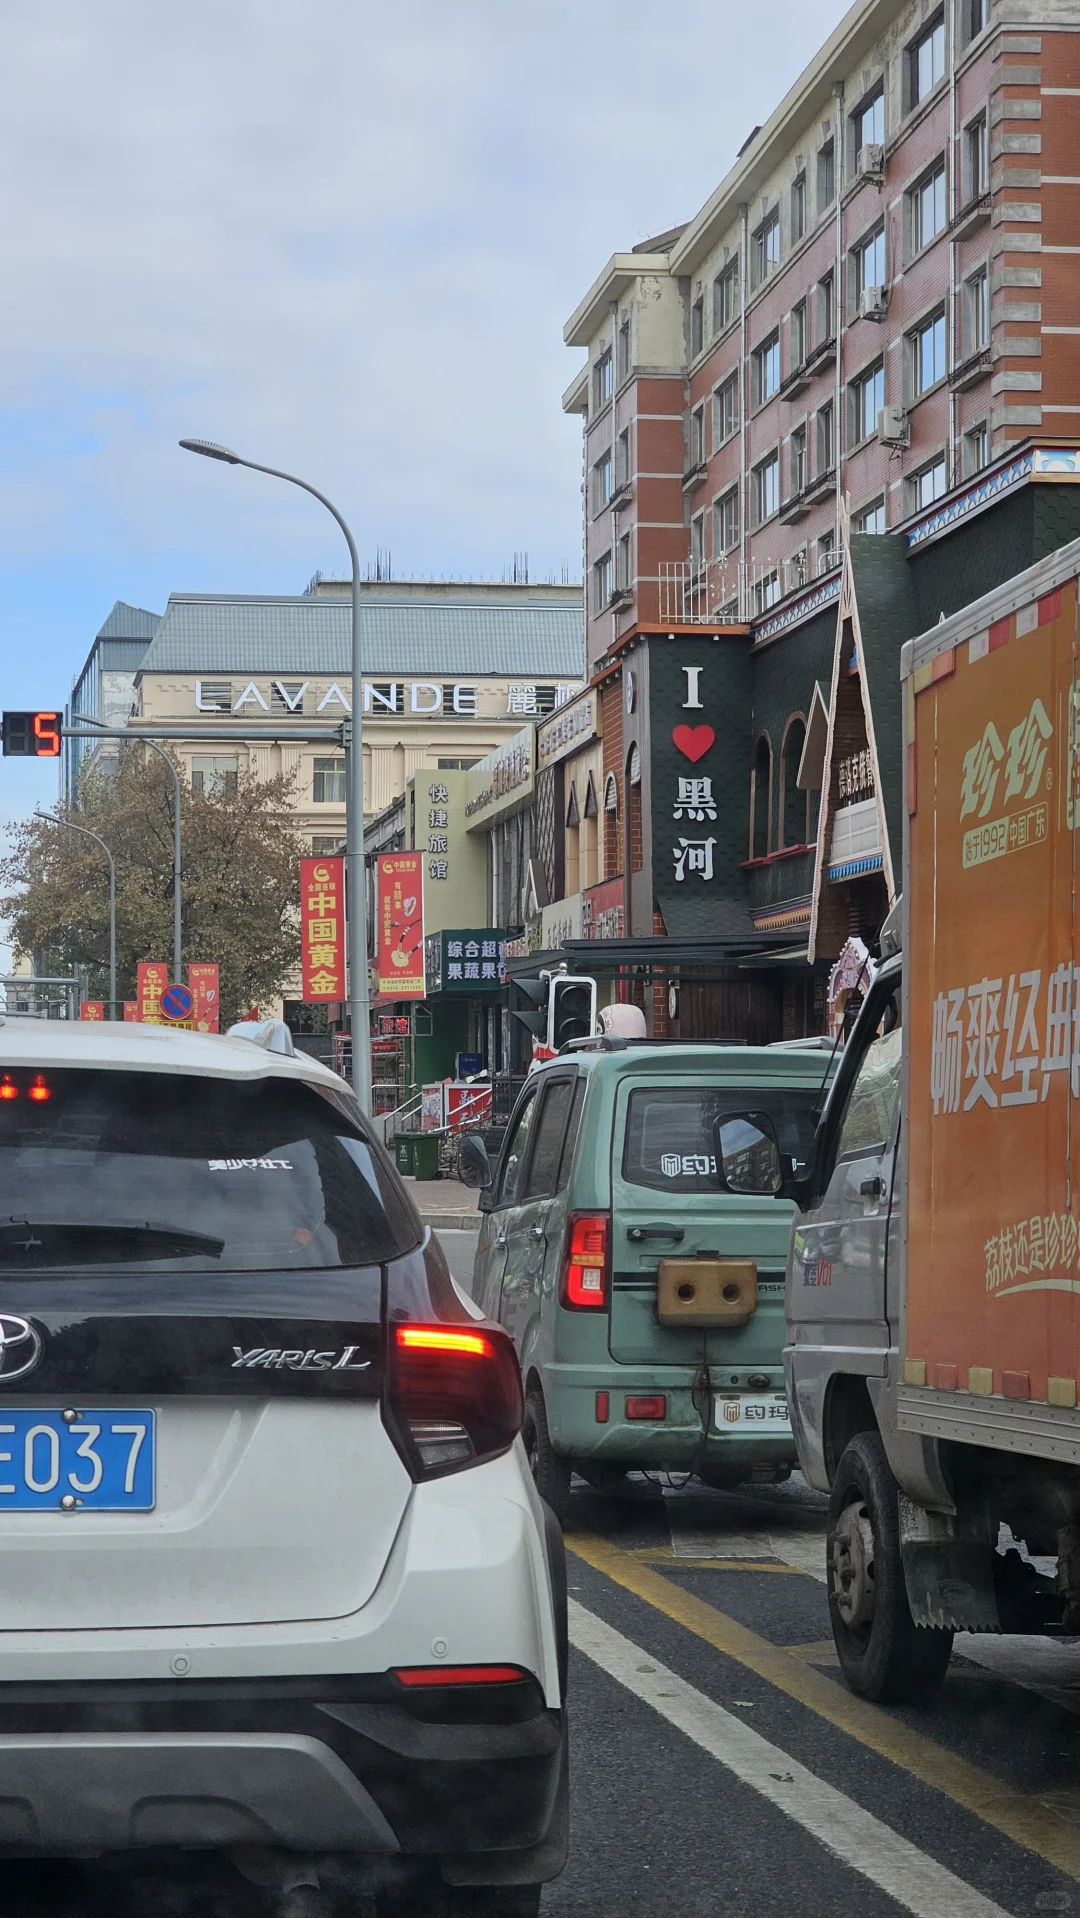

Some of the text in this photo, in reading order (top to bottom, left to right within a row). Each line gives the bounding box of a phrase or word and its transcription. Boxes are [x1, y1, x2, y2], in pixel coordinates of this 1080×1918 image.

[195, 679, 480, 714] LAVANDE
[681, 666, 704, 709] I
[35, 713, 59, 757] 5
[960, 698, 1054, 823] 珍珍
[429, 784, 448, 880] 快捷旅馆
[672, 776, 718, 882] 黑河
[965, 807, 1046, 862] 始于1992 中国广东
[307, 883, 336, 893] 全国连锁
[307, 892, 339, 995] 中国黄金
[381, 1018, 408, 1034] 旅馆
[931, 960, 1080, 1116] 畅爽经典
[682, 1154, 717, 1175] 约
[984, 1211, 1080, 1292] 荔枝还是珍珍
